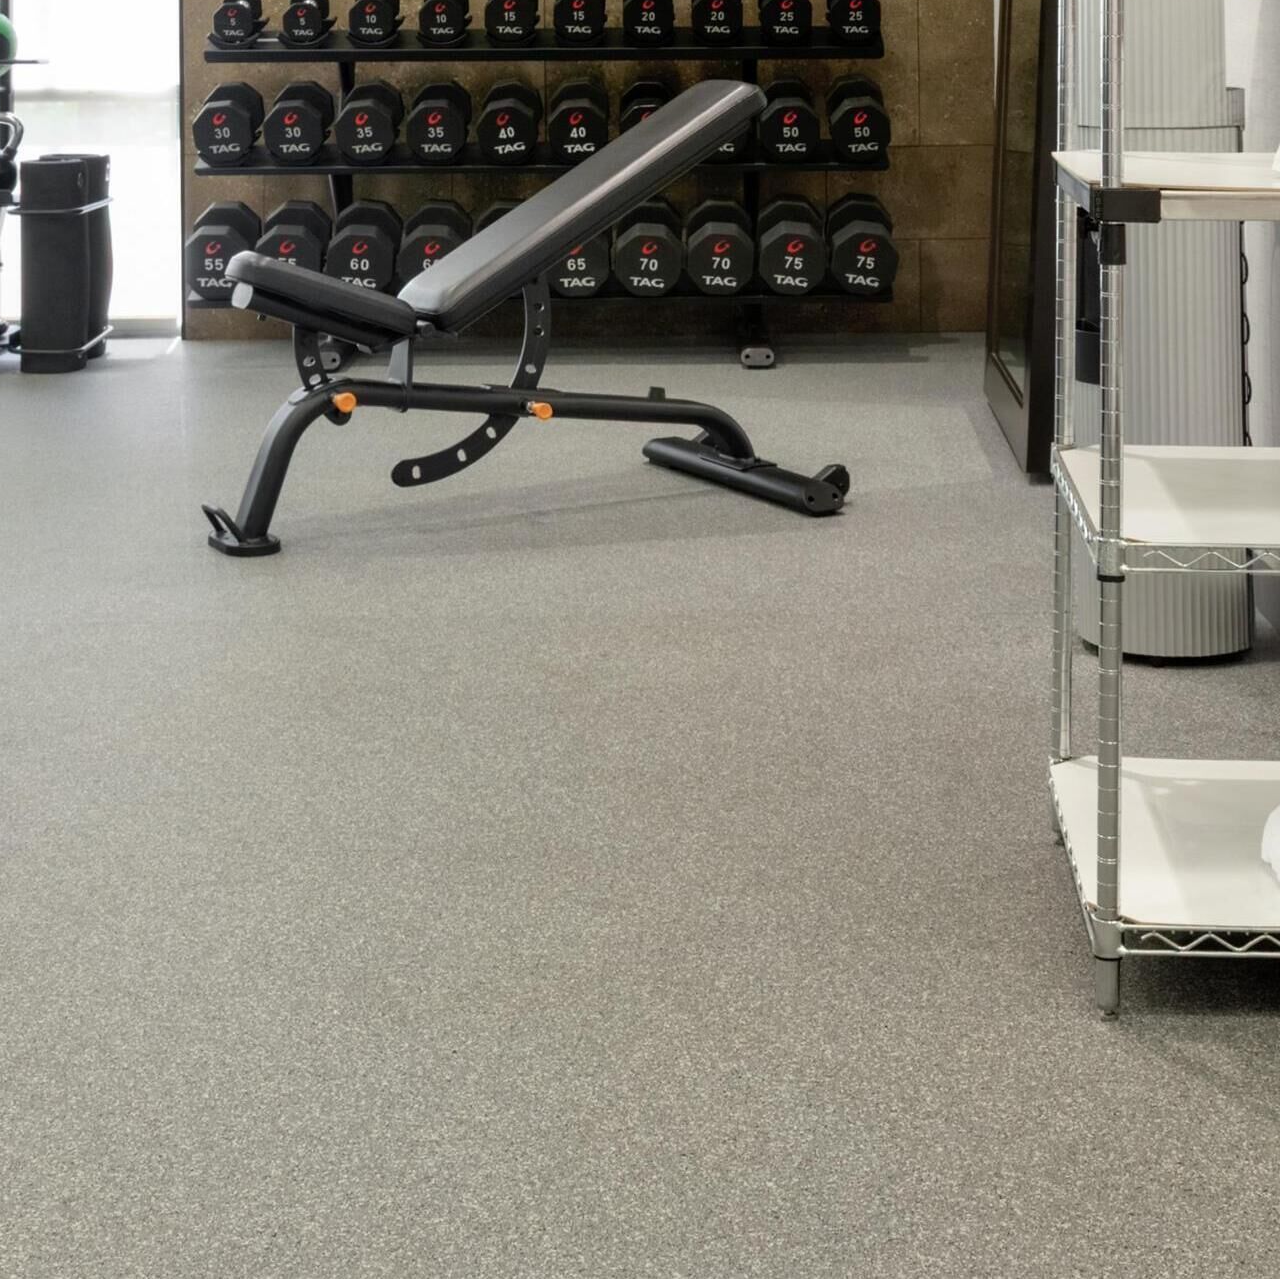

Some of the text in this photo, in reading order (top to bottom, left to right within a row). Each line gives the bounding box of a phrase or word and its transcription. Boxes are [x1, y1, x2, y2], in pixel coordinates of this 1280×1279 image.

[299, 17, 306, 26] 5
[365, 14, 377, 24] 10
[435, 13, 447, 24] 10
[504, 11, 516, 22] 15
[573, 10, 585, 21] 15
[641, 11, 656, 22] 20
[710, 11, 725, 21] 20
[779, 11, 794, 22] 25
[848, 10, 863, 22] 25
[229, 17, 237, 27] 5
[359, 27, 383, 35] TAG
[430, 26, 455, 35] TAG
[496, 25, 523, 35] TAG
[564, 25, 592, 34] TAG
[634, 25, 662, 35] TAG
[704, 25, 731, 34] TAG
[773, 25, 799, 35] TAG
[842, 25, 869, 34] TAG
[214, 126, 231, 140] 30
[284, 126, 302, 139] 30
[356, 126, 373, 139] 35
[427, 126, 444, 139] 35
[498, 126, 515, 139] 40
[569, 126, 587, 139] 40
[782, 126, 799, 138] 50
[853, 126, 871, 138] 50
[208, 143, 241, 154] TAG
[279, 142, 311, 153] TAG
[351, 142, 383, 154] TAG
[420, 143, 452, 153] TAG
[494, 141, 526, 155] TAG
[564, 142, 596, 153] TAG
[775, 142, 807, 153] TAG
[847, 141, 879, 153] TAG
[204, 258, 224, 271] 55
[349, 258, 370, 271] 60
[567, 257, 586, 271] 65
[639, 257, 659, 272] 70
[711, 256, 731, 270] 70
[784, 255, 804, 270] 75
[856, 255, 875, 270] 75
[196, 276, 233, 288] TAG
[340, 276, 377, 289] TAG
[559, 276, 596, 288] TAG
[630, 276, 665, 289] TAG
[702, 275, 737, 287] TAG
[773, 274, 808, 288] TAG
[845, 273, 879, 288] TAG
